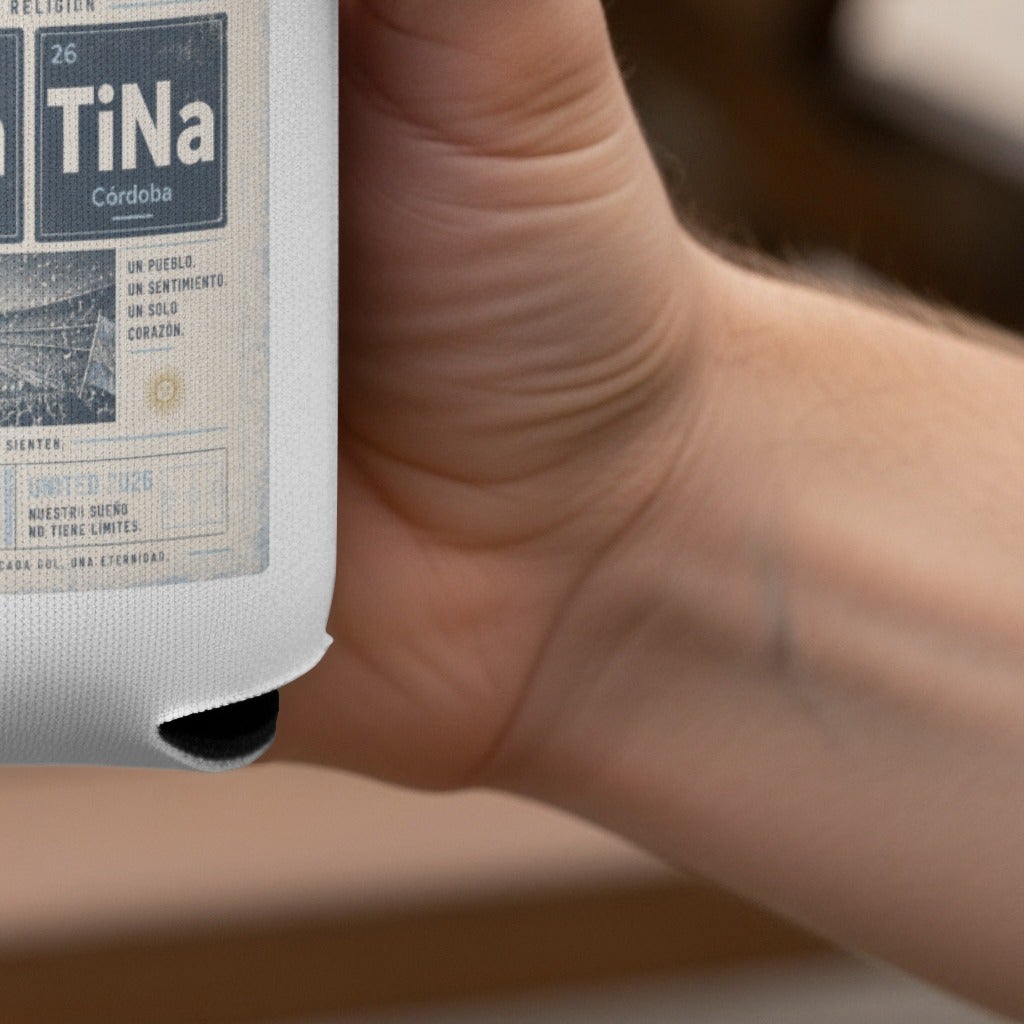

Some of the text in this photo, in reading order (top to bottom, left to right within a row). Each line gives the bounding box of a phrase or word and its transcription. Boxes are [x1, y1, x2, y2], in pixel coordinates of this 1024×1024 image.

[50, 43, 77, 64] 26
[46, 80, 215, 174] TiNa
[91, 182, 173, 207] Córdoba
[128, 260, 143, 274] UN
[128, 282, 143, 296] UN
[128, 301, 178, 318] UN SOLO
[28, 474, 100, 499] UNITED
[90, 499, 128, 519] SUEÑO
[28, 524, 45, 538] NO
[51, 523, 86, 537] TIENE
[71, 556, 94, 568] UNA
